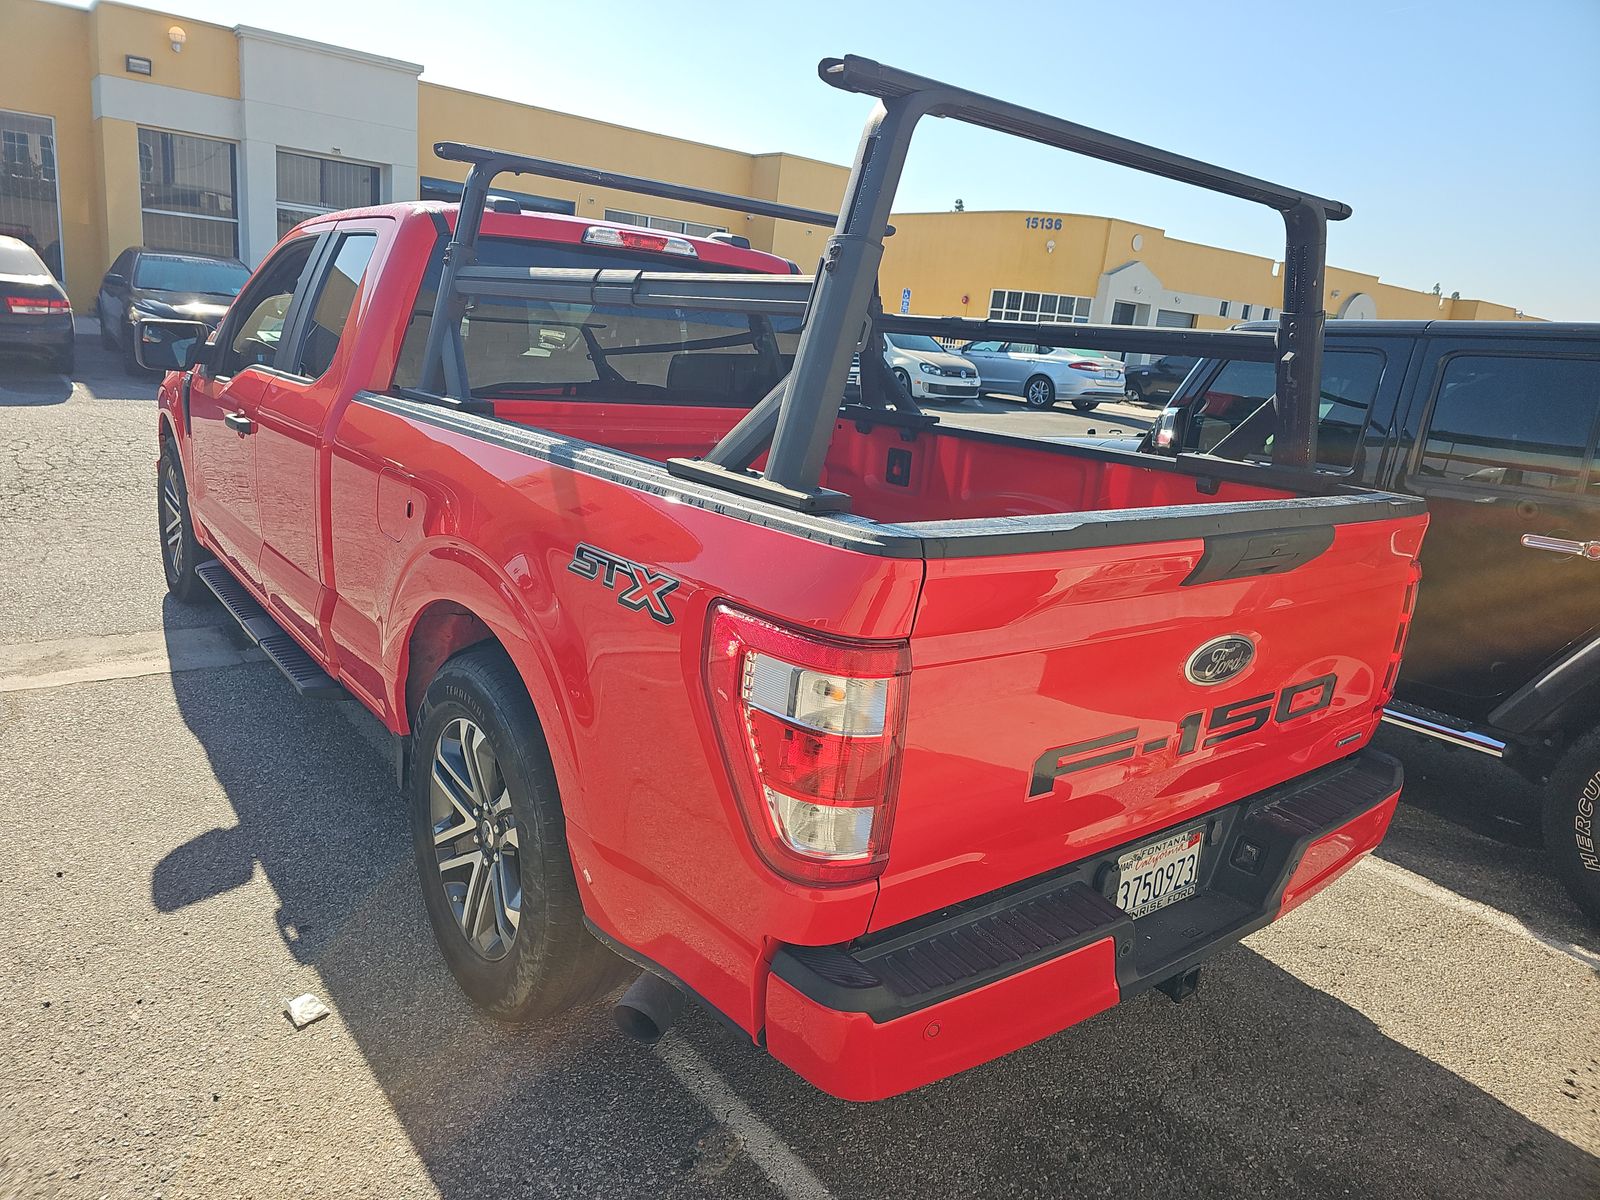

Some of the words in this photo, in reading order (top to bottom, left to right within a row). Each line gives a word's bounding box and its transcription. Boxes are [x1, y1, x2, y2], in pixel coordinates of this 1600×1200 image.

[1025, 217, 1062, 230] 15136
[567, 541, 680, 626] STX
[1205, 646, 1244, 678] Ford
[1028, 672, 1338, 799] F-150
[1575, 771, 1600, 872] HERCU
[1141, 835, 1186, 857] FONTANA
[1120, 861, 1133, 872] MAR
[1128, 899, 1163, 919] NRISE
[1167, 886, 1194, 904] FORD
